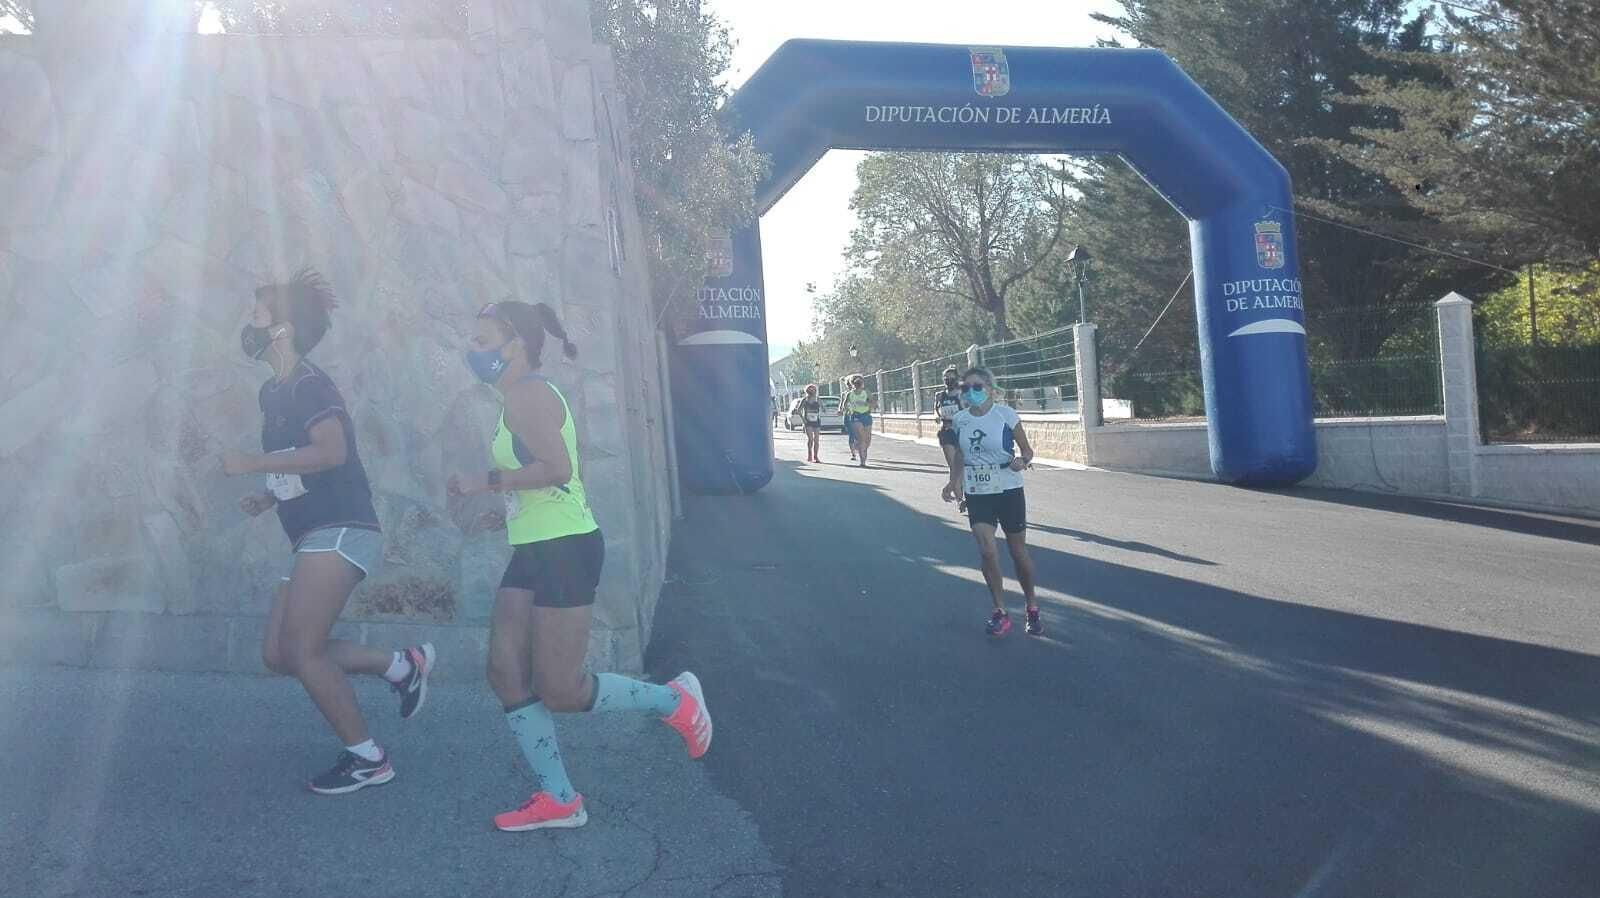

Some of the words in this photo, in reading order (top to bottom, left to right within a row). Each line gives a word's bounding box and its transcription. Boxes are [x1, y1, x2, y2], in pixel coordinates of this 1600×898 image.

[865, 103, 990, 124] DIPUTACIÓN
[996, 107, 1021, 124] DE
[1026, 104, 1112, 125] ALMERÍA
[696, 284, 760, 301] UTACIÓN
[1223, 277, 1303, 296] DIPUTACIÓ
[699, 302, 760, 319] ALMERÍA
[1226, 298, 1248, 312] DE
[974, 473, 991, 482] 160
